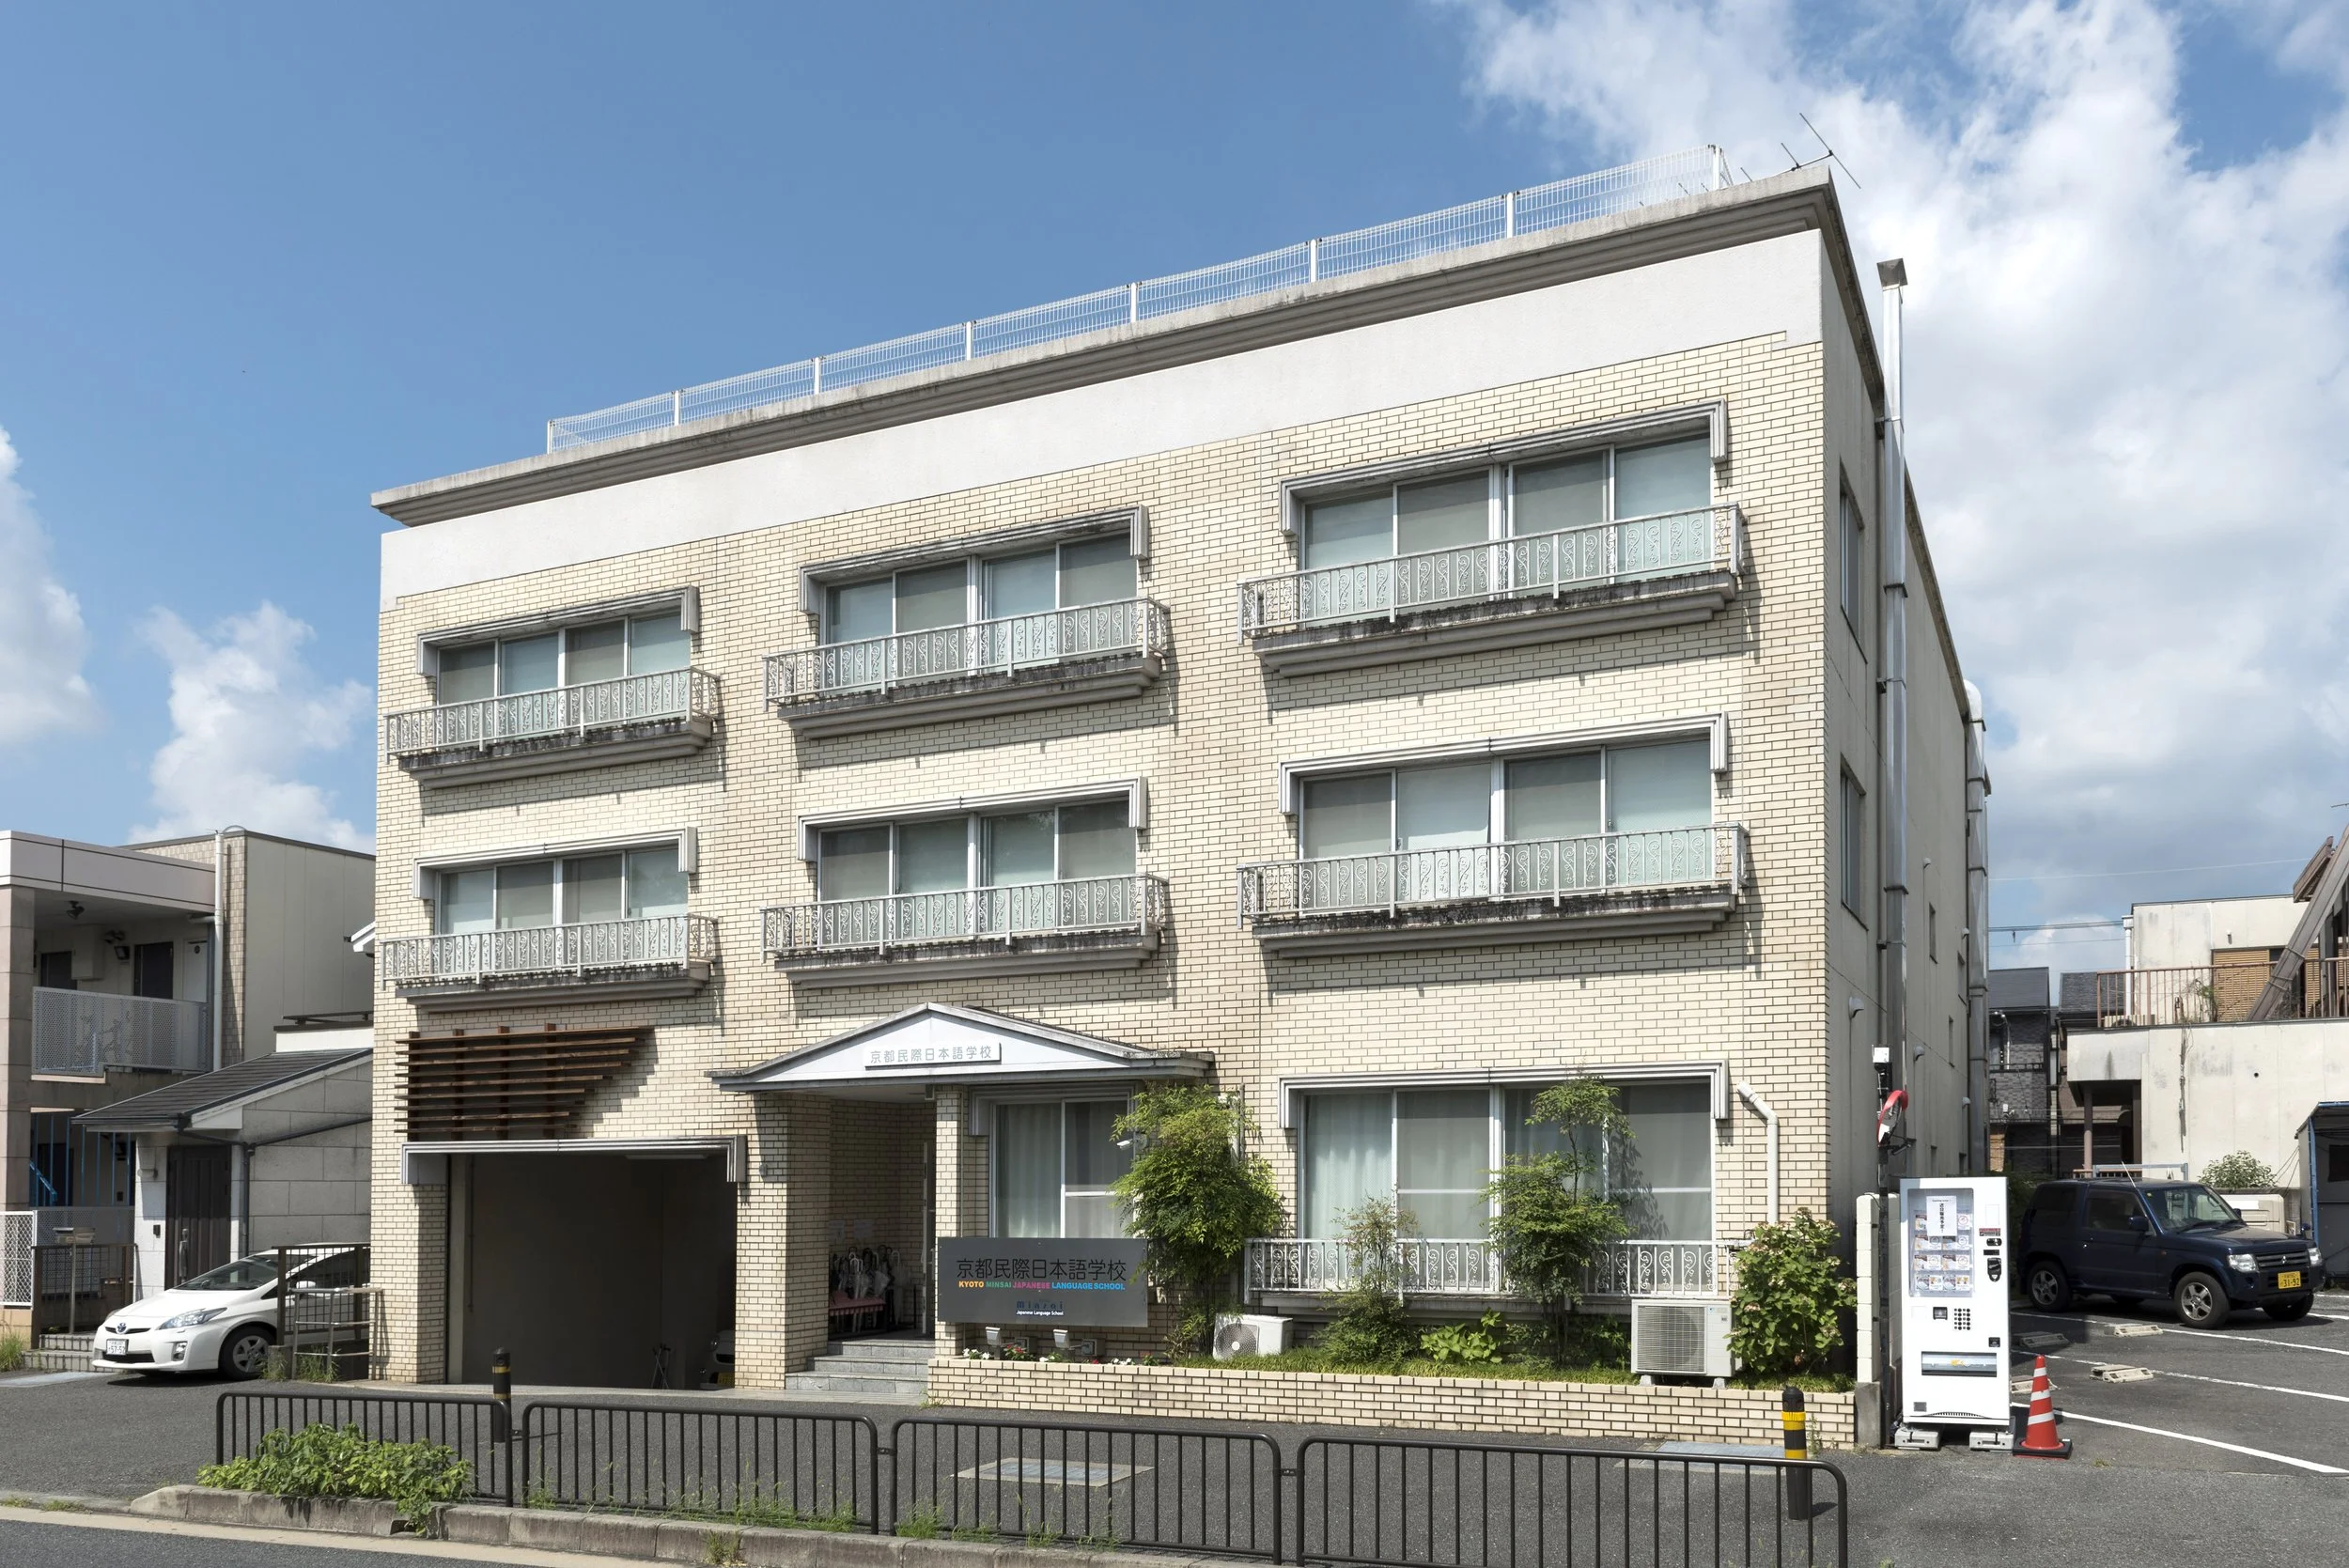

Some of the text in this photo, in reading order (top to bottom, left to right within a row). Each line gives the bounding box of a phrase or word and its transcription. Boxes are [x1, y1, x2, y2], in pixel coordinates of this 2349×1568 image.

[870, 1046, 991, 1063] 京都民際日本語学校
[957, 1258, 1127, 1281] 京都民際日本語学校
